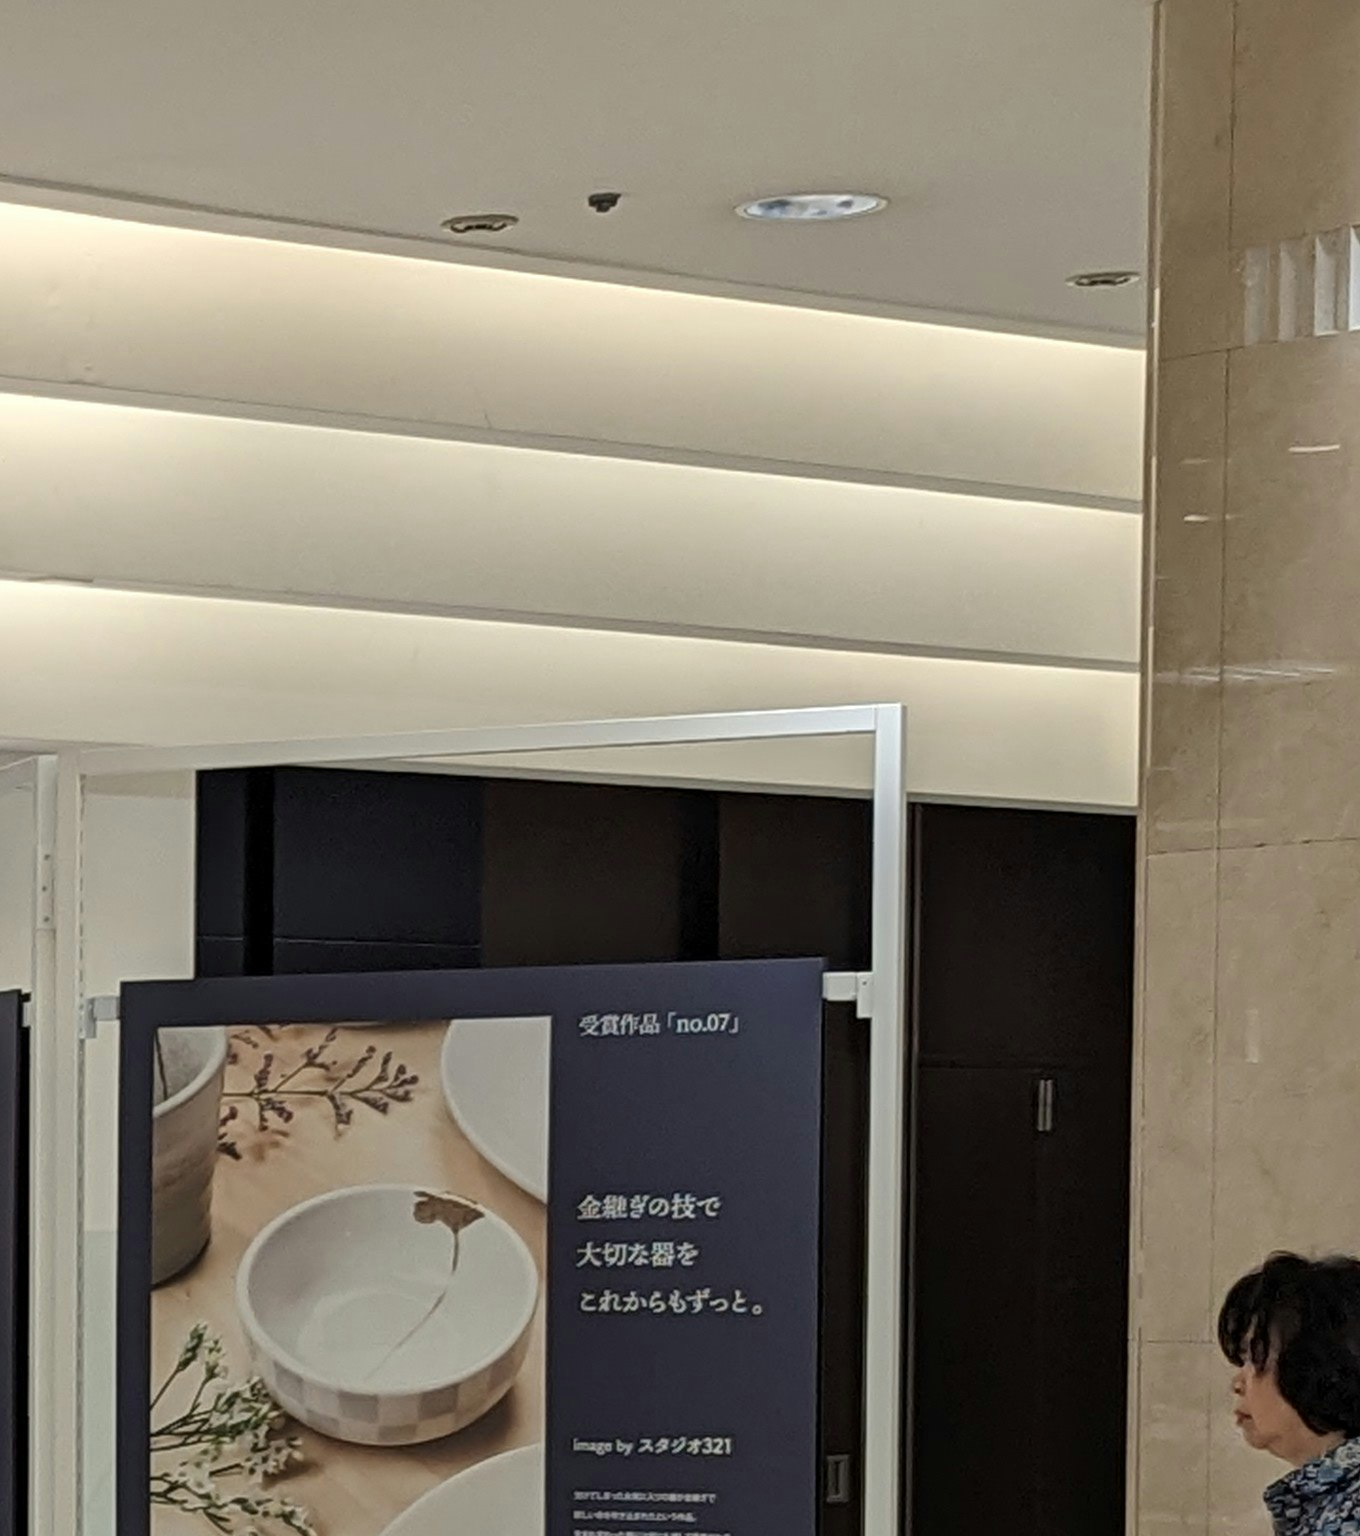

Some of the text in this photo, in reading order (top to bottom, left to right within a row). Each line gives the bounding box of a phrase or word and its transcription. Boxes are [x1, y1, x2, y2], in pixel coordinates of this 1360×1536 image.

[577, 1194, 721, 1219] 金継ぎの技で
[576, 1243, 699, 1267] 大切な器を
[580, 1290, 763, 1316] これからもずっと。
[574, 1437, 731, 1455] image by スタジオ321
